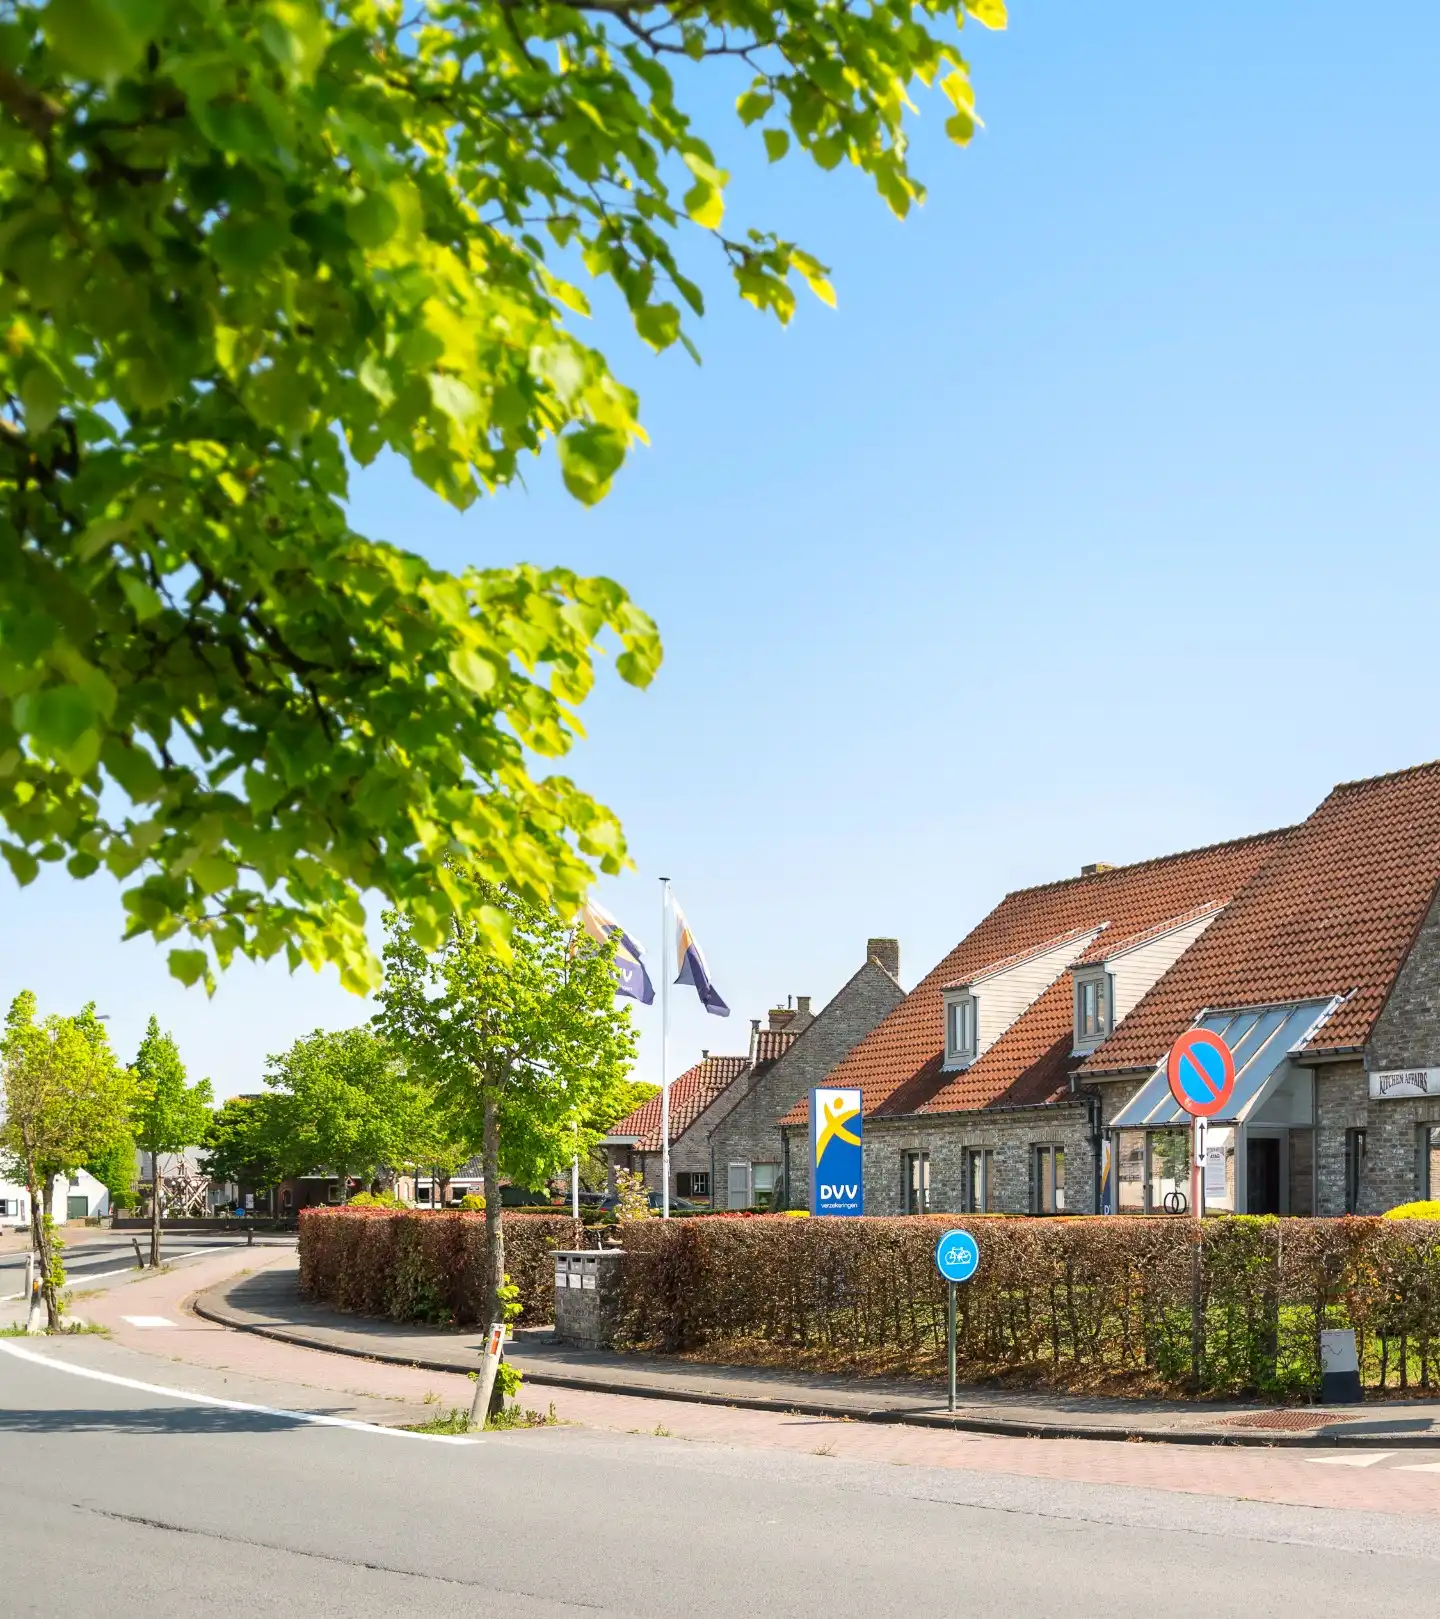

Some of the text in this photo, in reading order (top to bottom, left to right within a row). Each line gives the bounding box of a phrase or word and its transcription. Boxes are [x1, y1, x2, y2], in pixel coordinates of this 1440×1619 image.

[1379, 1071, 1428, 1095] KITCHEN AFFAIRS
[820, 1184, 858, 1200] DVV
[820, 1202, 858, 1210] verzekeringen
